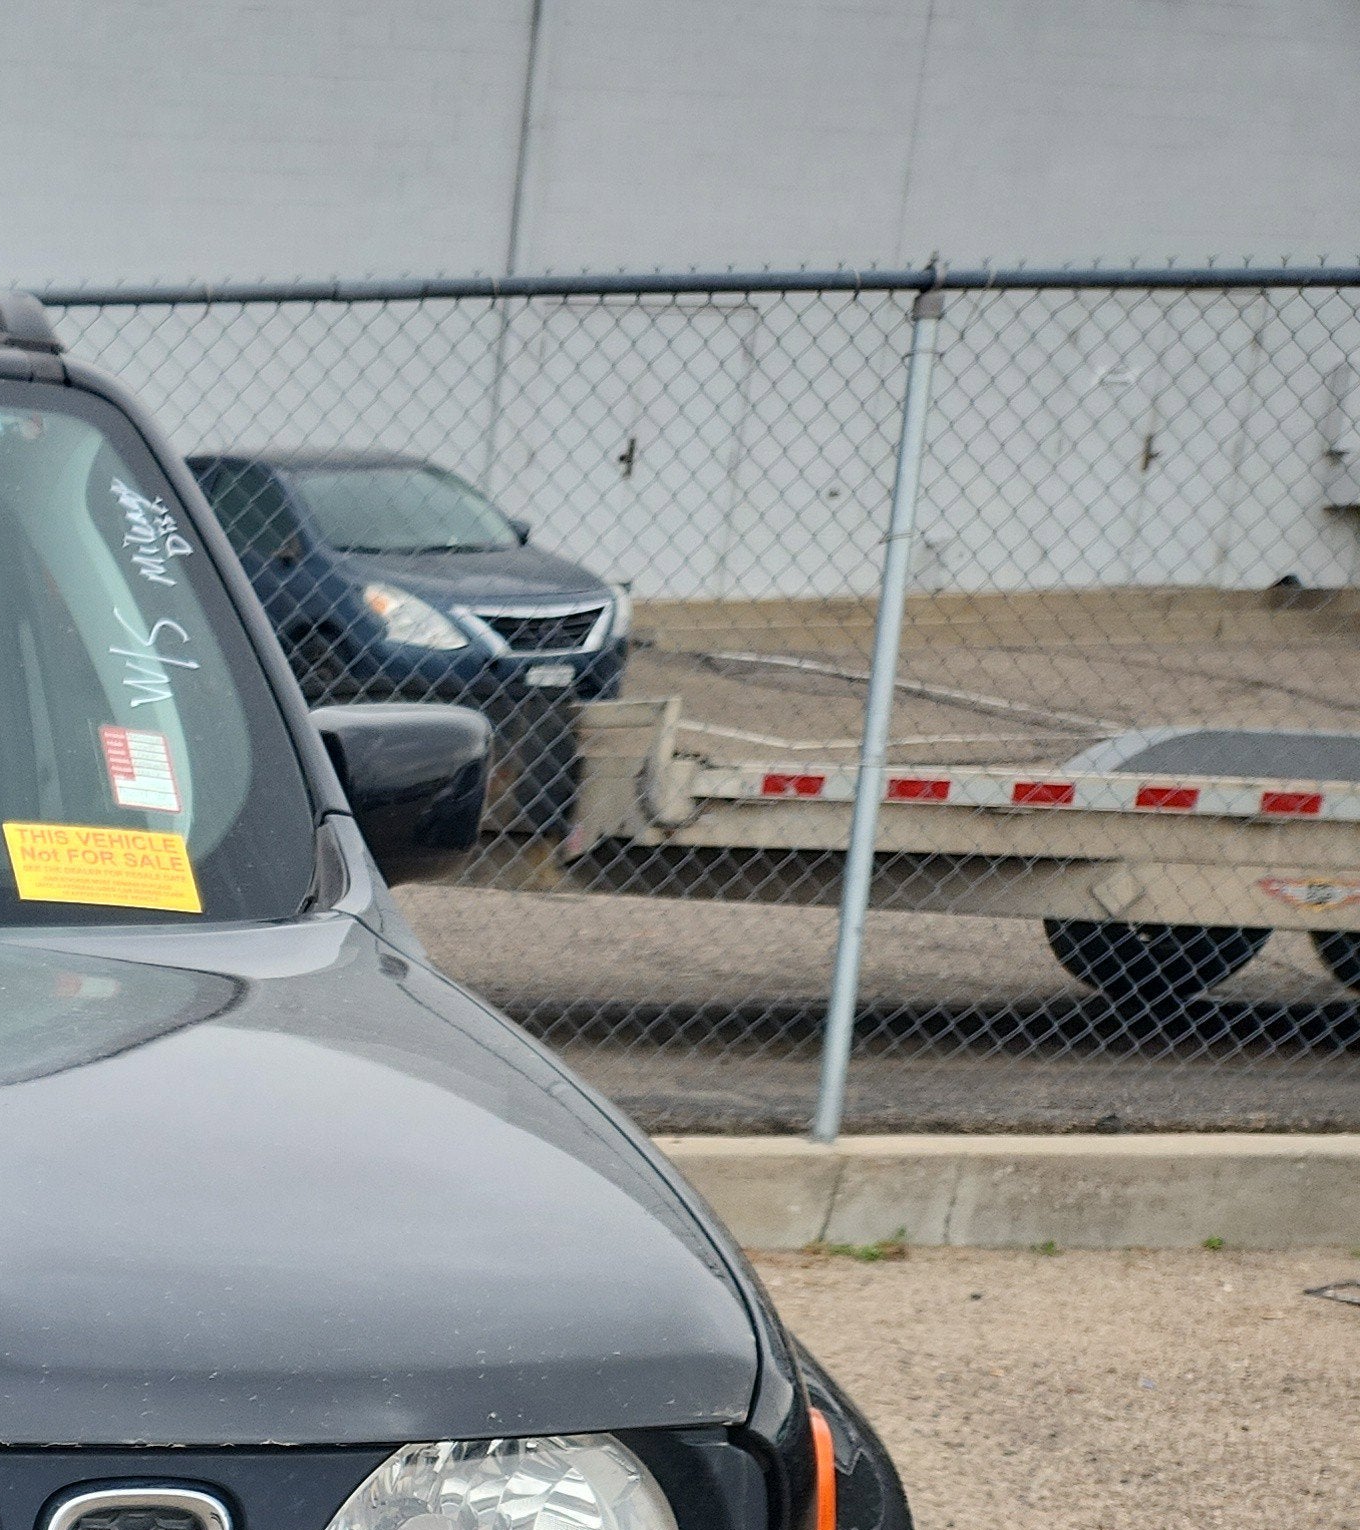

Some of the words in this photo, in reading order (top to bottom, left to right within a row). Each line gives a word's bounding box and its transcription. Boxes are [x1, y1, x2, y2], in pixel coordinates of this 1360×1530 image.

[15, 827, 69, 845] THIS
[75, 831, 179, 854] VEHICLE
[20, 846, 61, 863] Not
[67, 848, 118, 867] FOR
[123, 852, 185, 872] SALE
